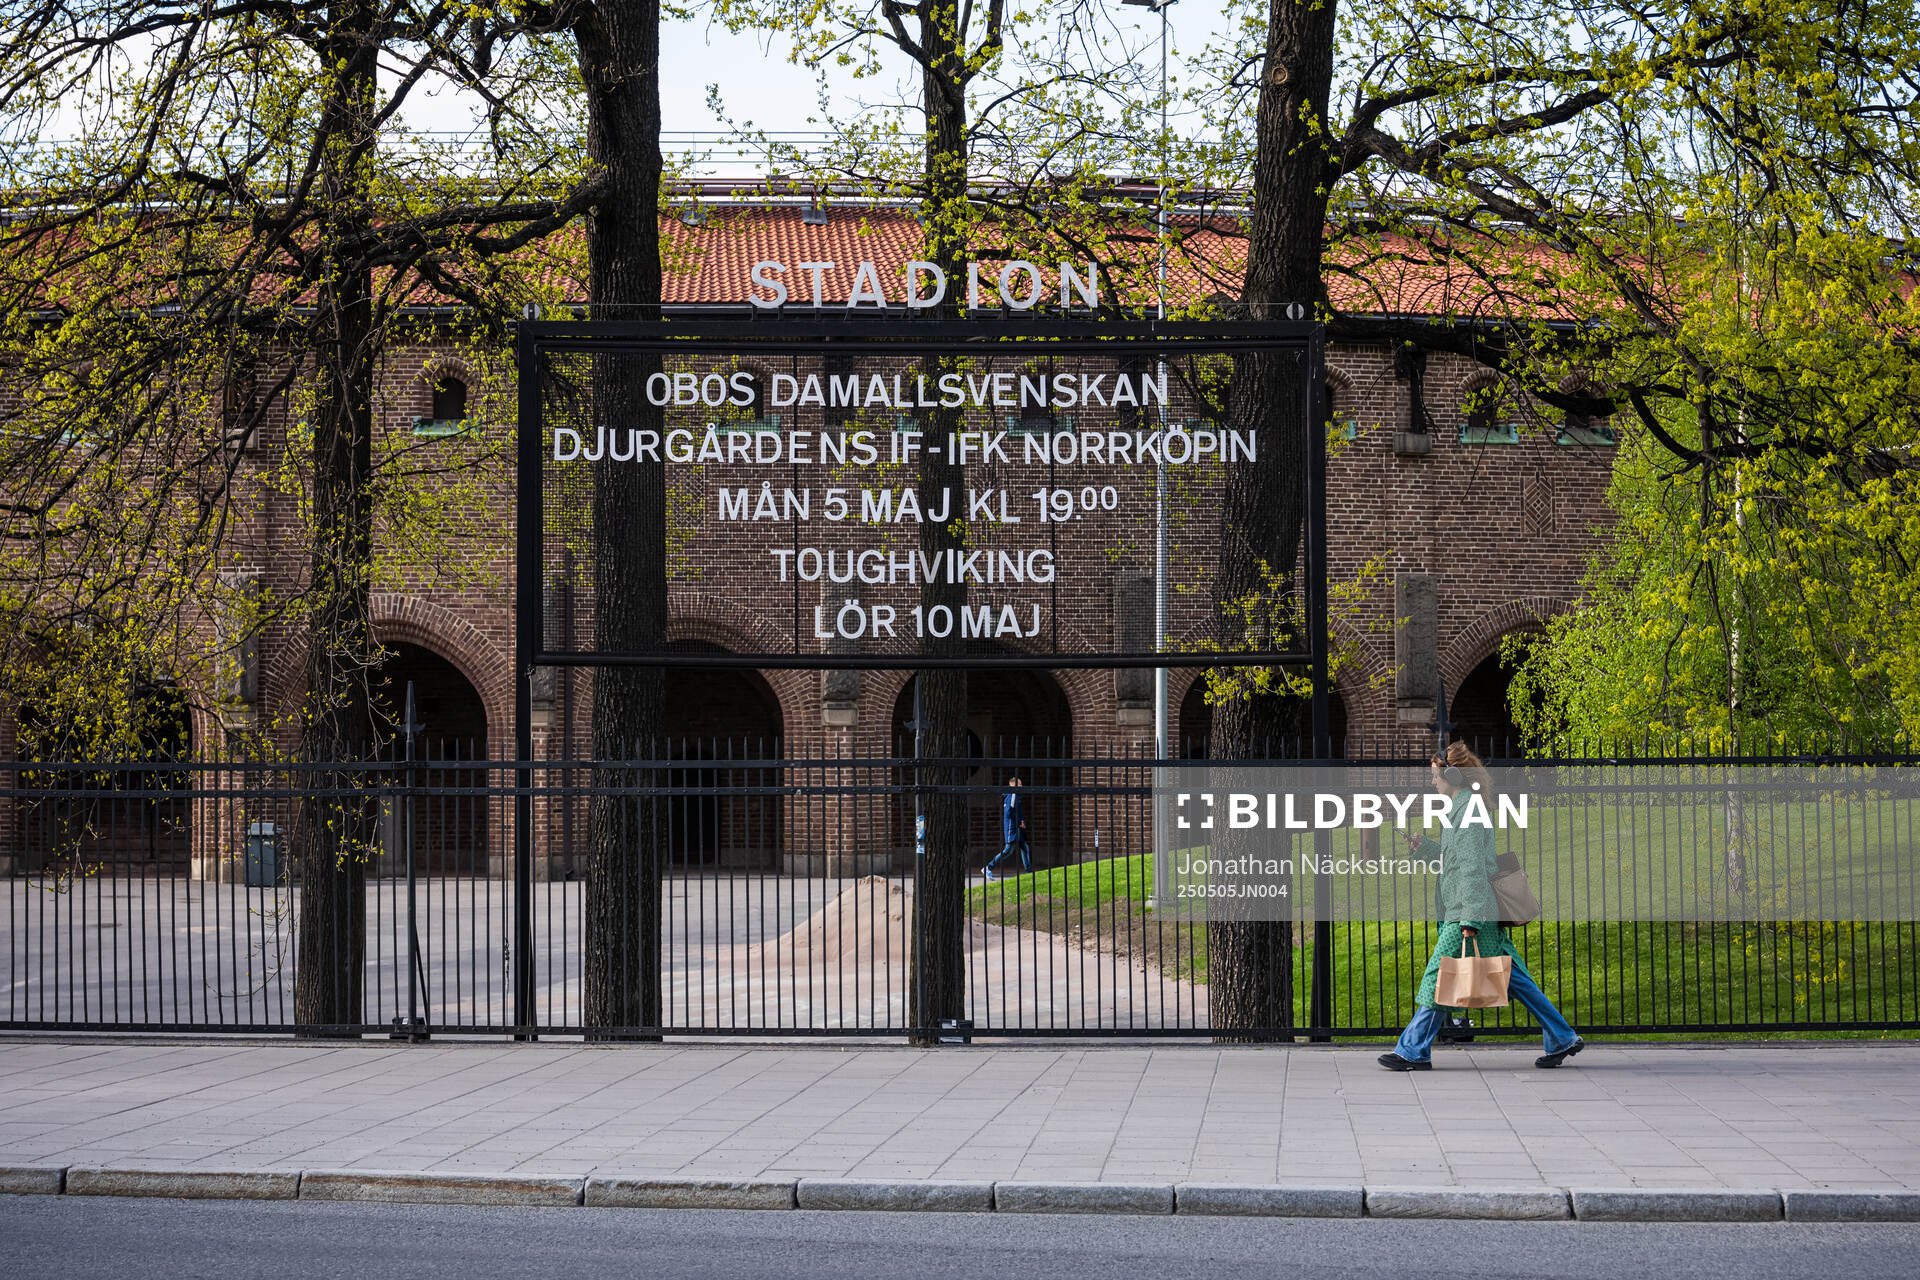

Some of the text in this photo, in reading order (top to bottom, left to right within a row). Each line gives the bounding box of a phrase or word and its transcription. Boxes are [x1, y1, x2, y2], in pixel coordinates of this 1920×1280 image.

[748, 261, 1099, 310] STADION
[645, 372, 1169, 409] OBOS DAMALLSVENSKAN
[553, 422, 878, 465] DJURGÅRDENS
[1024, 424, 1257, 464] NORRKÖPIN
[718, 480, 810, 522] MÅN
[823, 488, 849, 522] 5
[861, 487, 951, 523] MAJ
[969, 488, 1021, 523] KL
[770, 547, 1056, 584] TOUGHVIKING
[814, 598, 898, 640] LÖR
